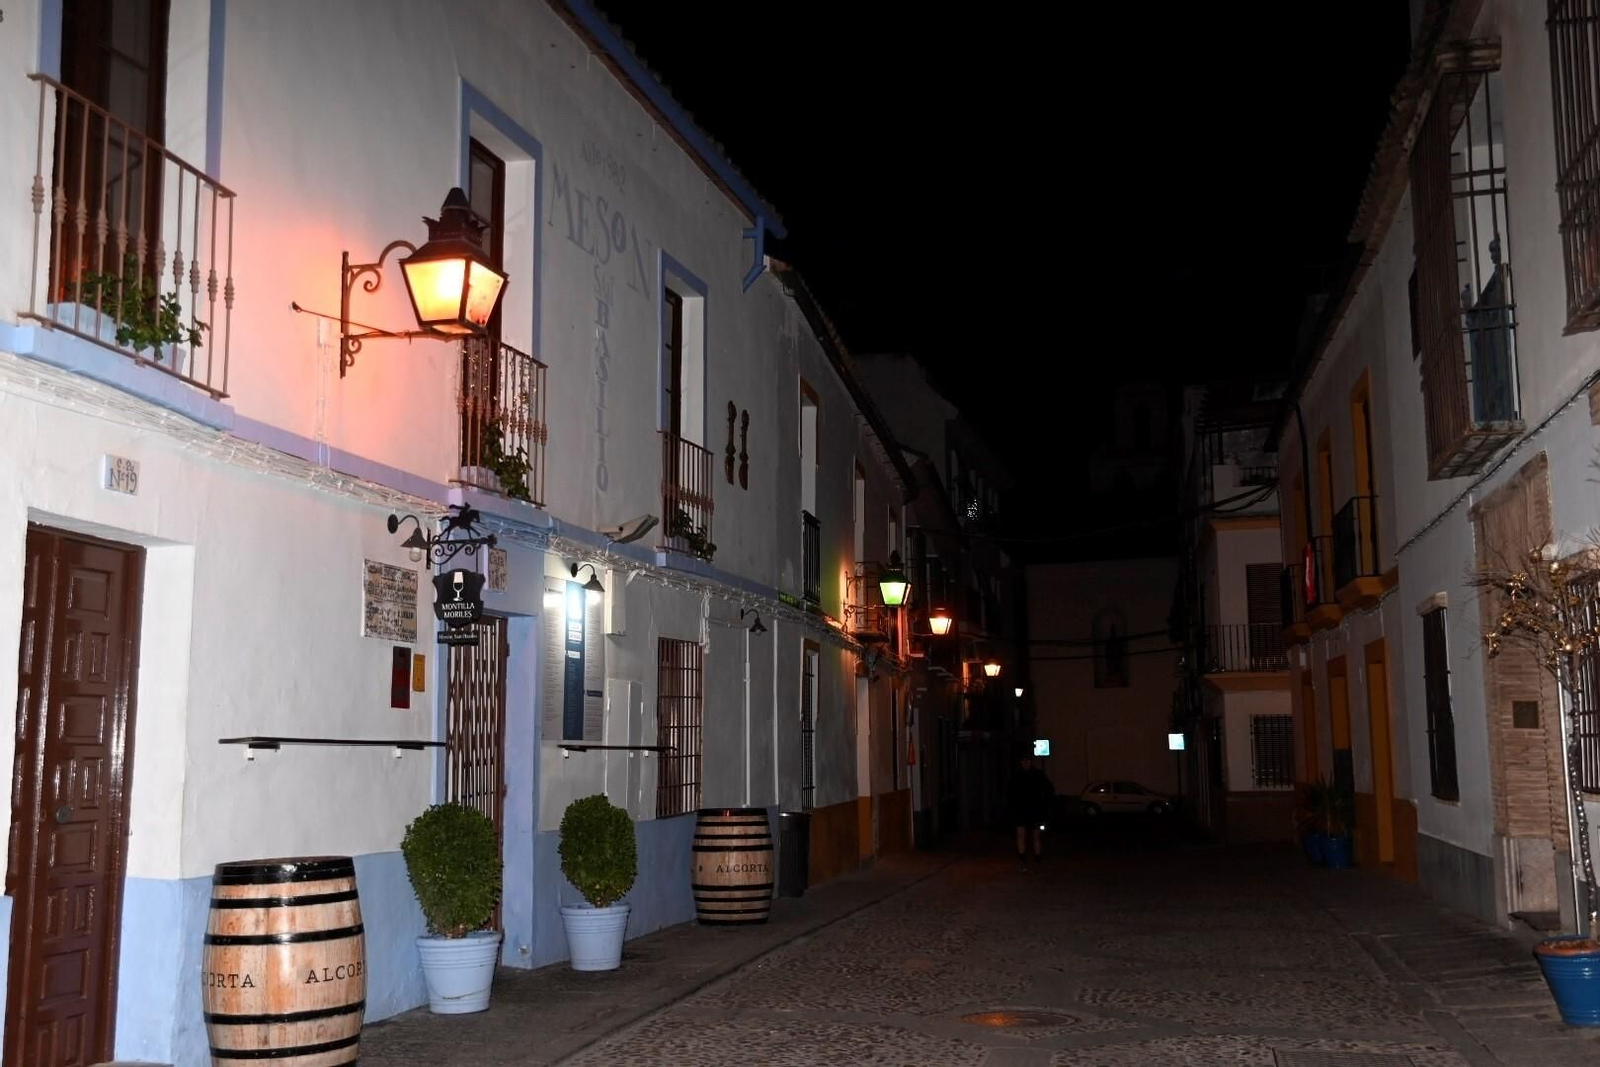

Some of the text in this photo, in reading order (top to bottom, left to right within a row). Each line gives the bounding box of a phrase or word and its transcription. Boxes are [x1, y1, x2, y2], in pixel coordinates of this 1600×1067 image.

[441, 602, 475, 611] MONTILLA
[443, 610, 473, 619] MORILES
[716, 863, 769, 874] ALCORTA
